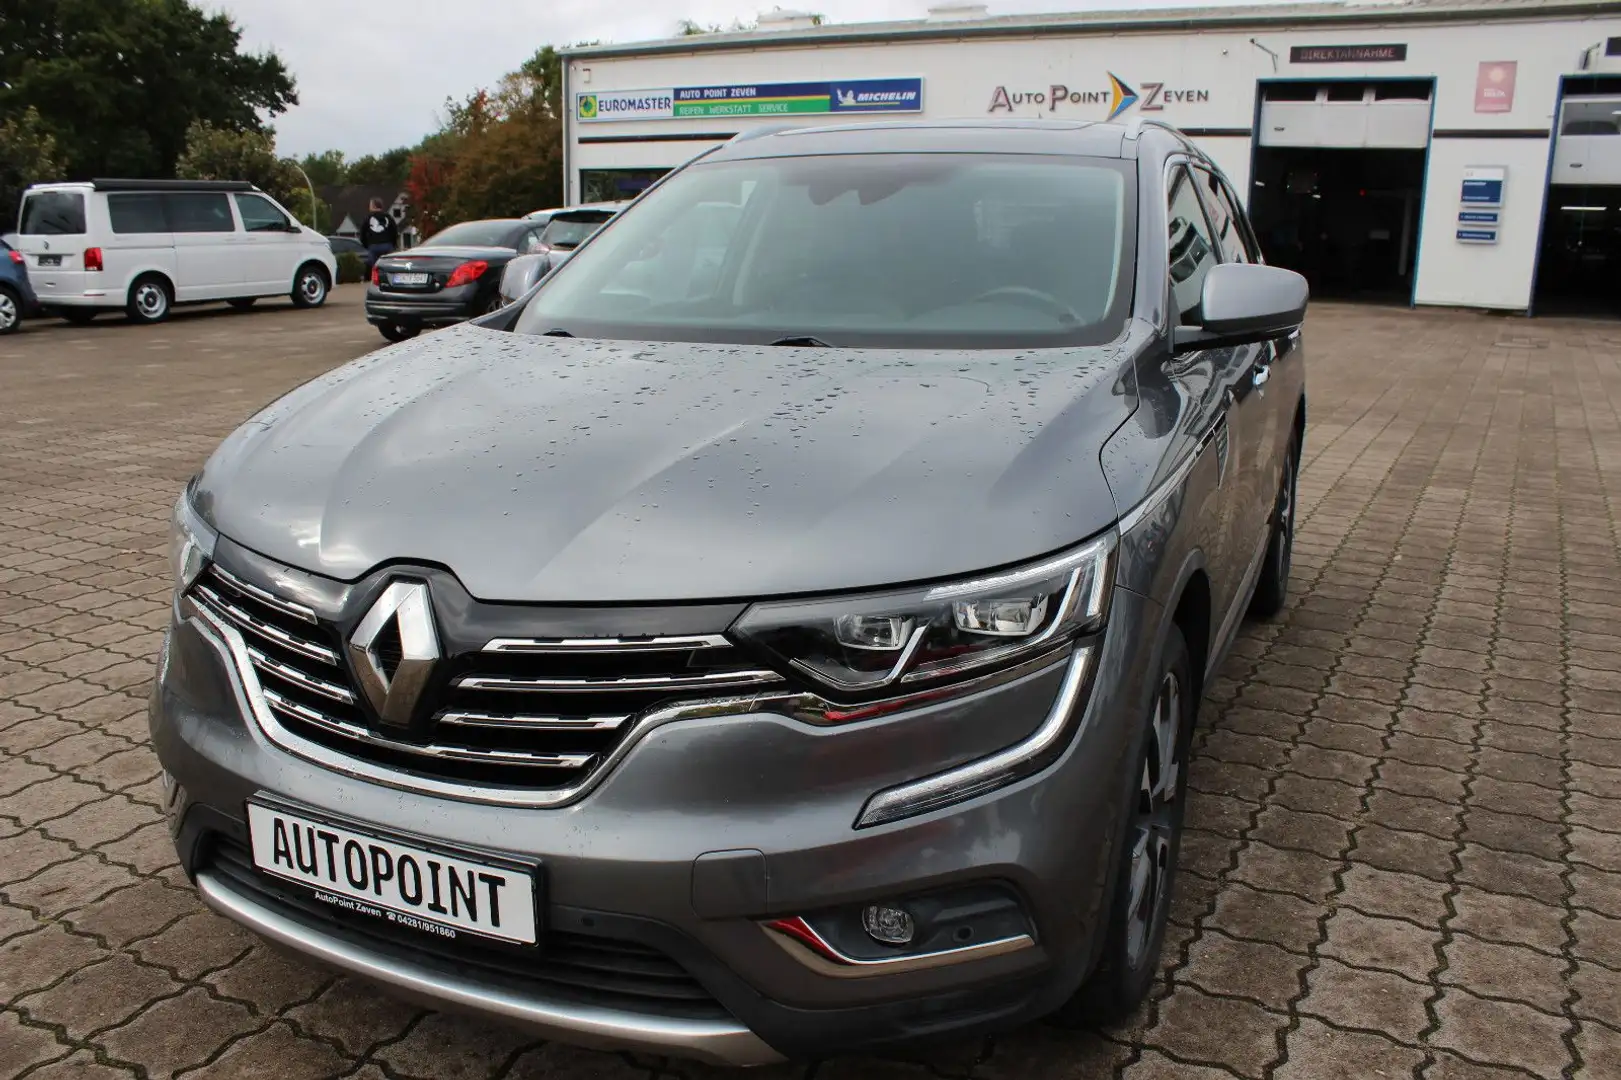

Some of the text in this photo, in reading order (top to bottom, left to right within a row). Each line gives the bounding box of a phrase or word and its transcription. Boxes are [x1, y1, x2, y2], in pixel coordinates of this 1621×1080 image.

[1300, 47, 1396, 60] DIREKTANNAHME
[680, 87, 756, 99] AUTO POINT ZEVEN
[857, 91, 916, 102] MICHELIN
[598, 97, 671, 112] EUROMASTER
[679, 103, 788, 115] REIFEN WERKSTATT SERVICE
[273, 816, 505, 927] AUTOPOINT
[315, 891, 456, 939] AutoPoint Zeven 04281/951860
